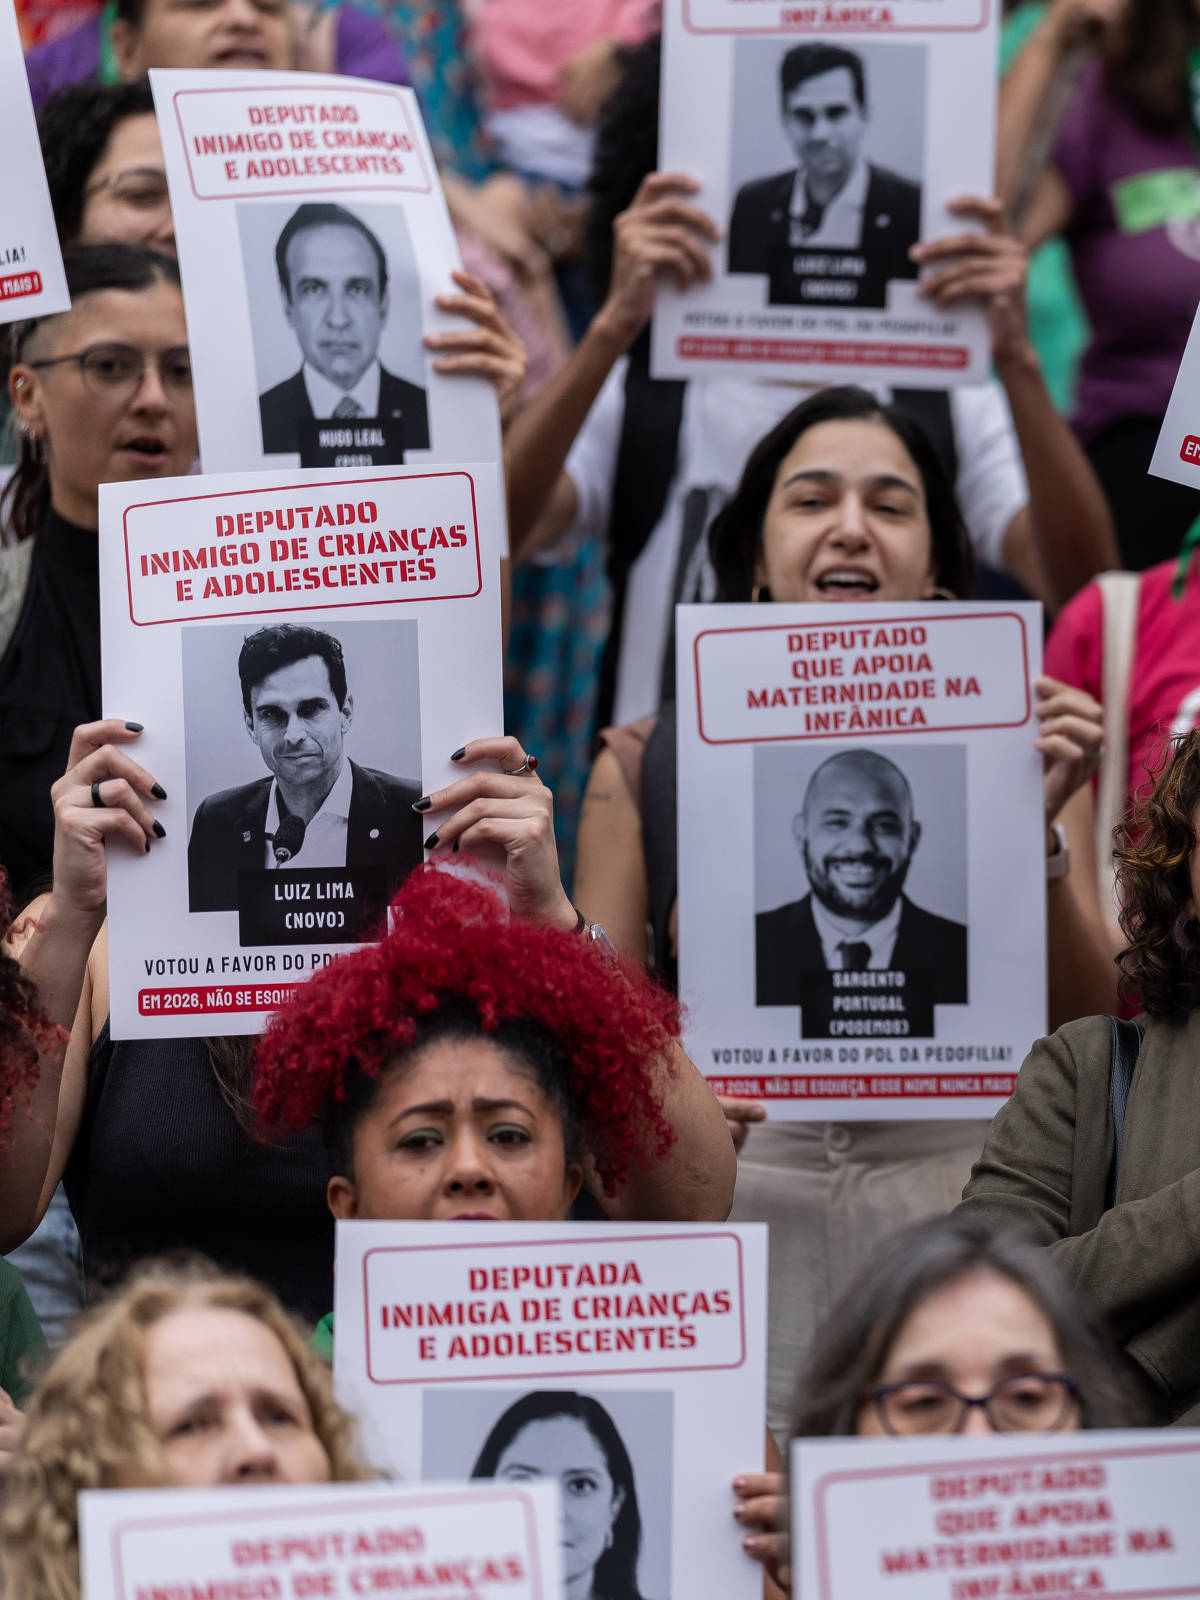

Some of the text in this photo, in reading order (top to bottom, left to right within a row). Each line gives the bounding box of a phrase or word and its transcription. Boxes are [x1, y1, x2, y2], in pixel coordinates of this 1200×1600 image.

[248, 105, 359, 126] DEPUTADO
[193, 130, 414, 155] INIMIGO DE CRIANÇAS
[224, 155, 404, 180] E ADOLESCENTES
[215, 501, 378, 537] DEPUTADO
[140, 525, 468, 576] INIMIGO DE CRIANÇAS
[176, 557, 437, 602] E ADOLESCENTES
[787, 626, 927, 653] DEPUTADO
[792, 653, 933, 681] QUE APOIA
[747, 676, 981, 708] MATERNIDADE NA
[805, 705, 927, 732] INFÂNICA
[274, 882, 354, 901] LUIZ LIMA
[285, 911, 345, 929] (NOVO)
[145, 953, 339, 976] VOTOU A FAVOR DO PD
[832, 971, 905, 988] SARGENTO
[142, 994, 161, 1010] EM
[163, 992, 204, 1010] 2026,
[206, 988, 233, 1007] NÃO
[235, 990, 252, 1006] SE
[833, 996, 906, 1012] PORTUGAL
[829, 1019, 909, 1036] (PODEMOS)
[712, 1046, 1012, 1063] VOTOU A FAVOR DO PDL DA PEDOFILIA!
[469, 1261, 643, 1292] DEPUTADA
[381, 1289, 731, 1330] INIMIGA DE CRIANÇAS
[419, 1325, 697, 1360] E ADOLESCENTES
[930, 1465, 1106, 1501] DEPUTADO
[231, 1526, 424, 1566] DEPUTADO
